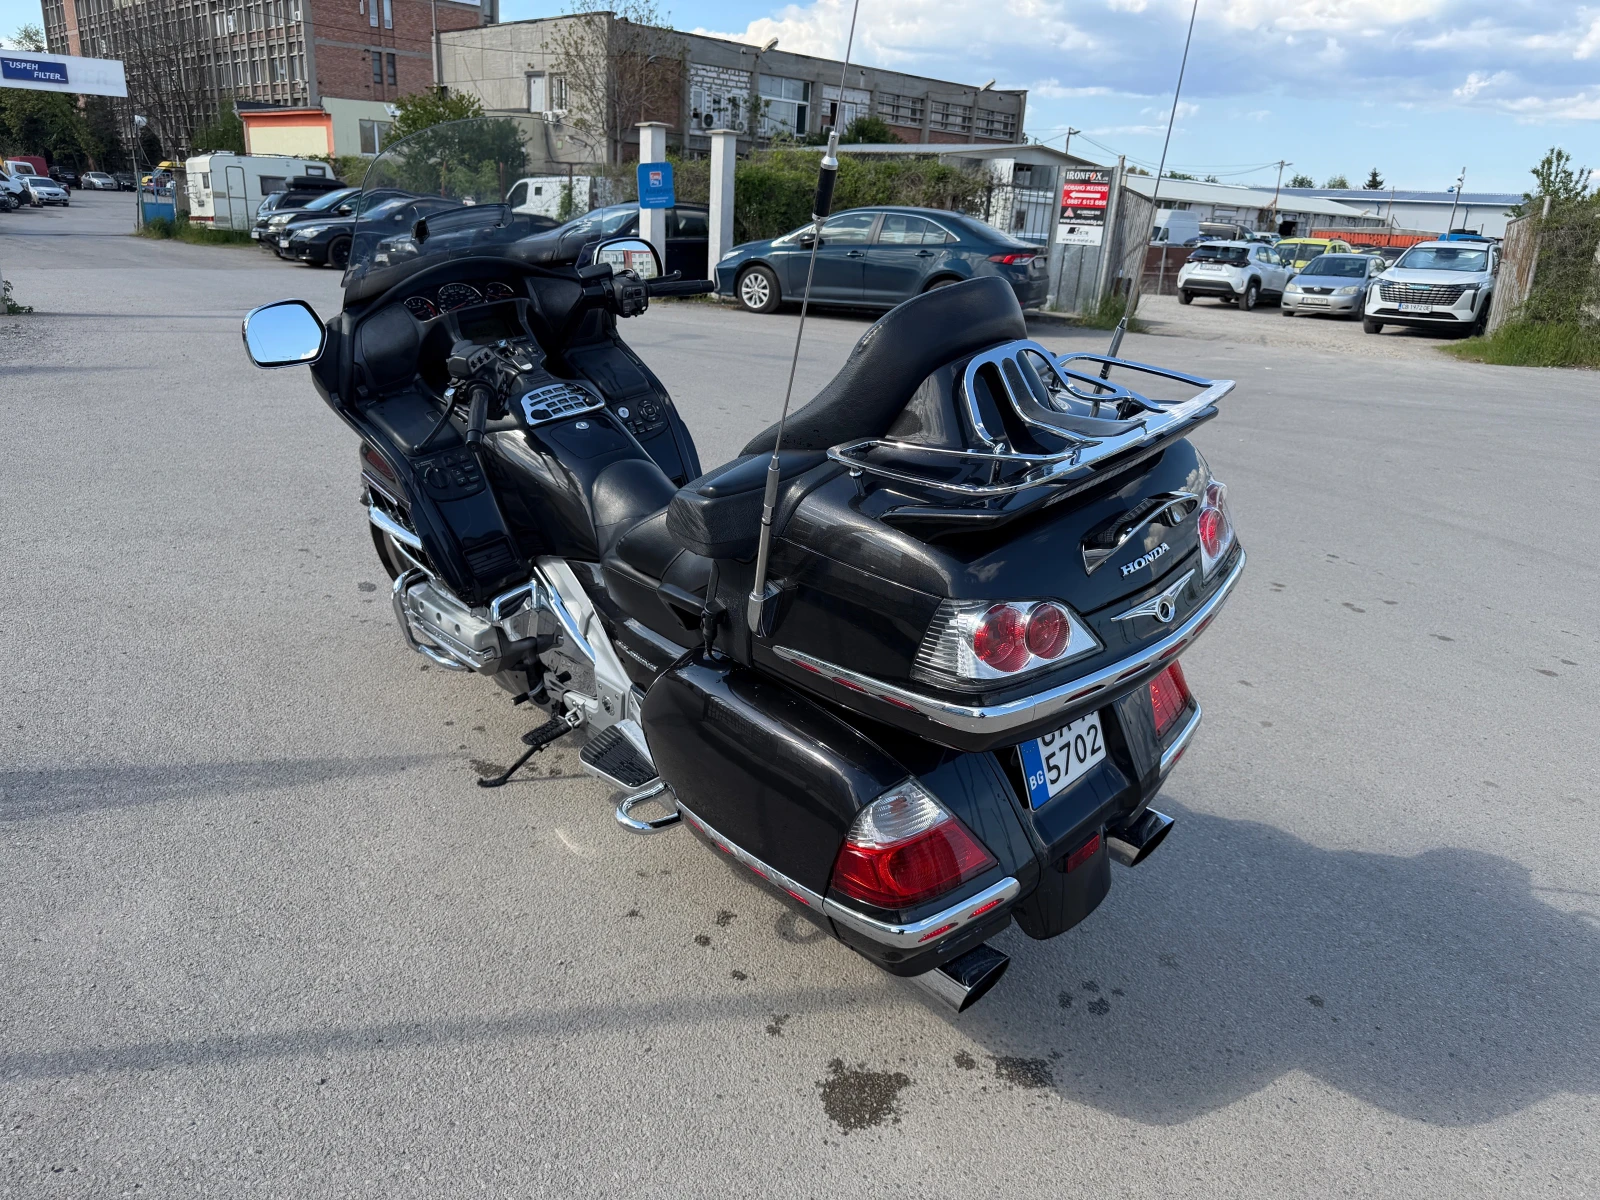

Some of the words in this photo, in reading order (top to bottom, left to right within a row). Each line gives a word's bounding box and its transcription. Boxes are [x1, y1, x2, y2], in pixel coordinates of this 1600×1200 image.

[9, 62, 39, 70] USPEH
[33, 71, 61, 80] FILTER
[1120, 542, 1170, 577] HONDA
[1045, 724, 1102, 785] 5702
[1029, 770, 1044, 790] BG
